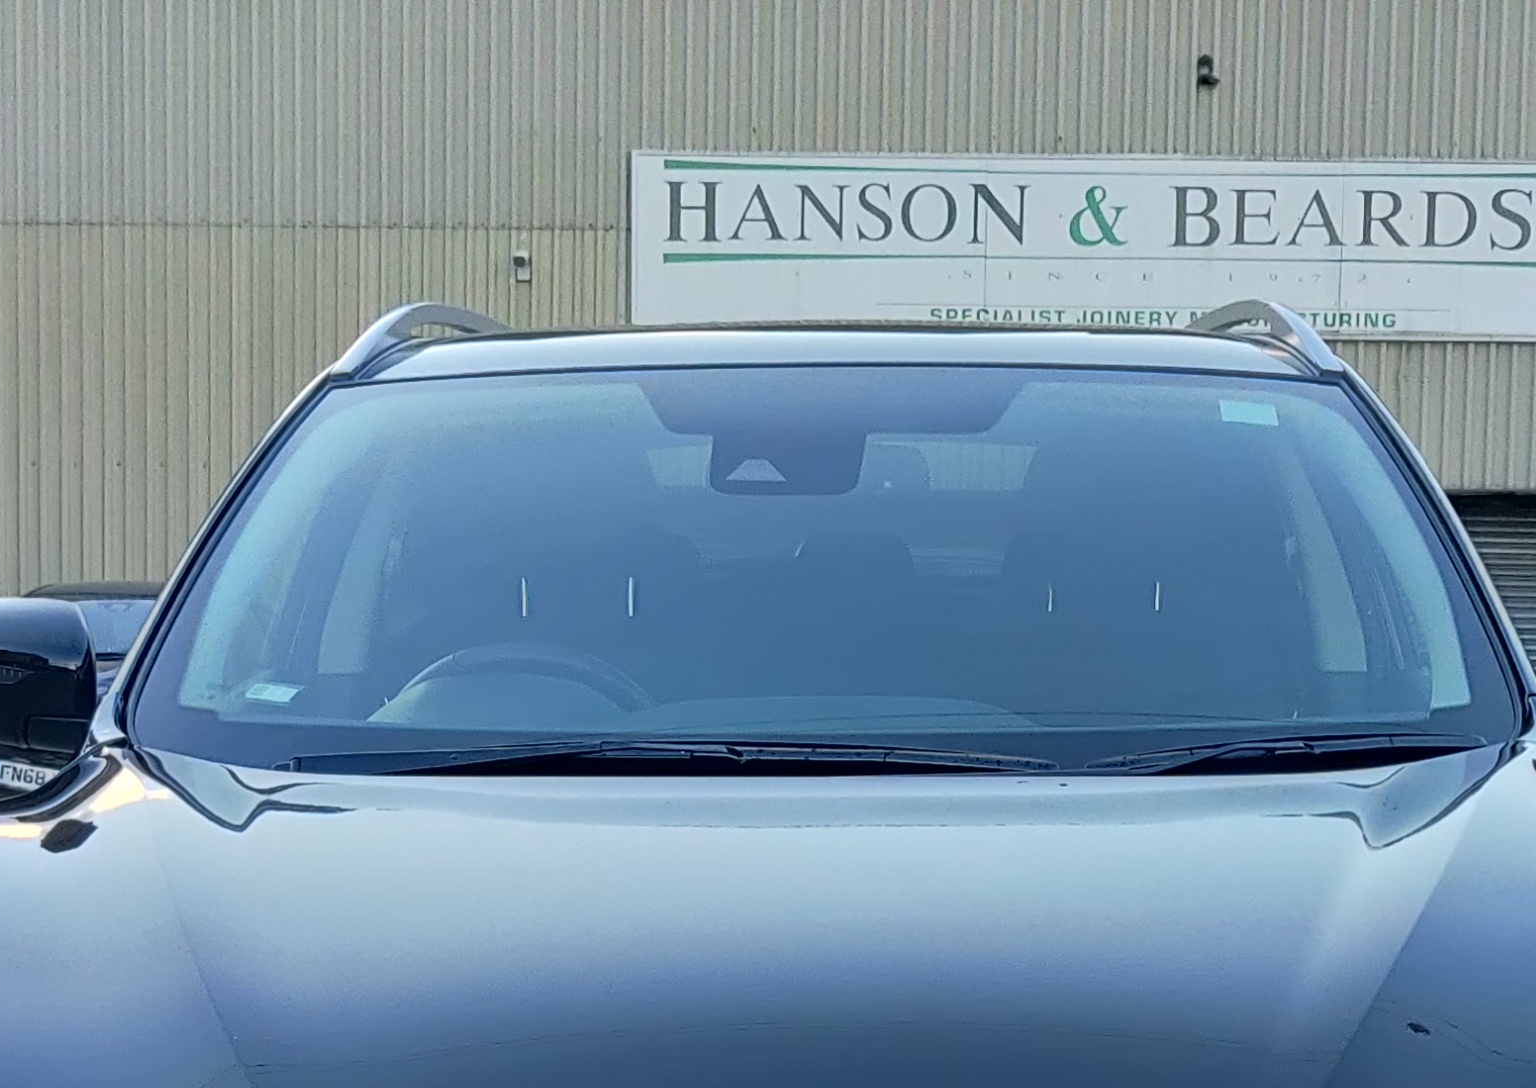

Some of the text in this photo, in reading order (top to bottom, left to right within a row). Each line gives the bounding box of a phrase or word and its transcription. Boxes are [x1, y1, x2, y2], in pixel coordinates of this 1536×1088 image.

[663, 180, 1032, 247] HANSON
[1068, 185, 1128, 248] &
[1168, 185, 1533, 252] BEARDS
[930, 308, 1065, 323] SPECIALIST
[1076, 310, 1178, 326] JOINERY
